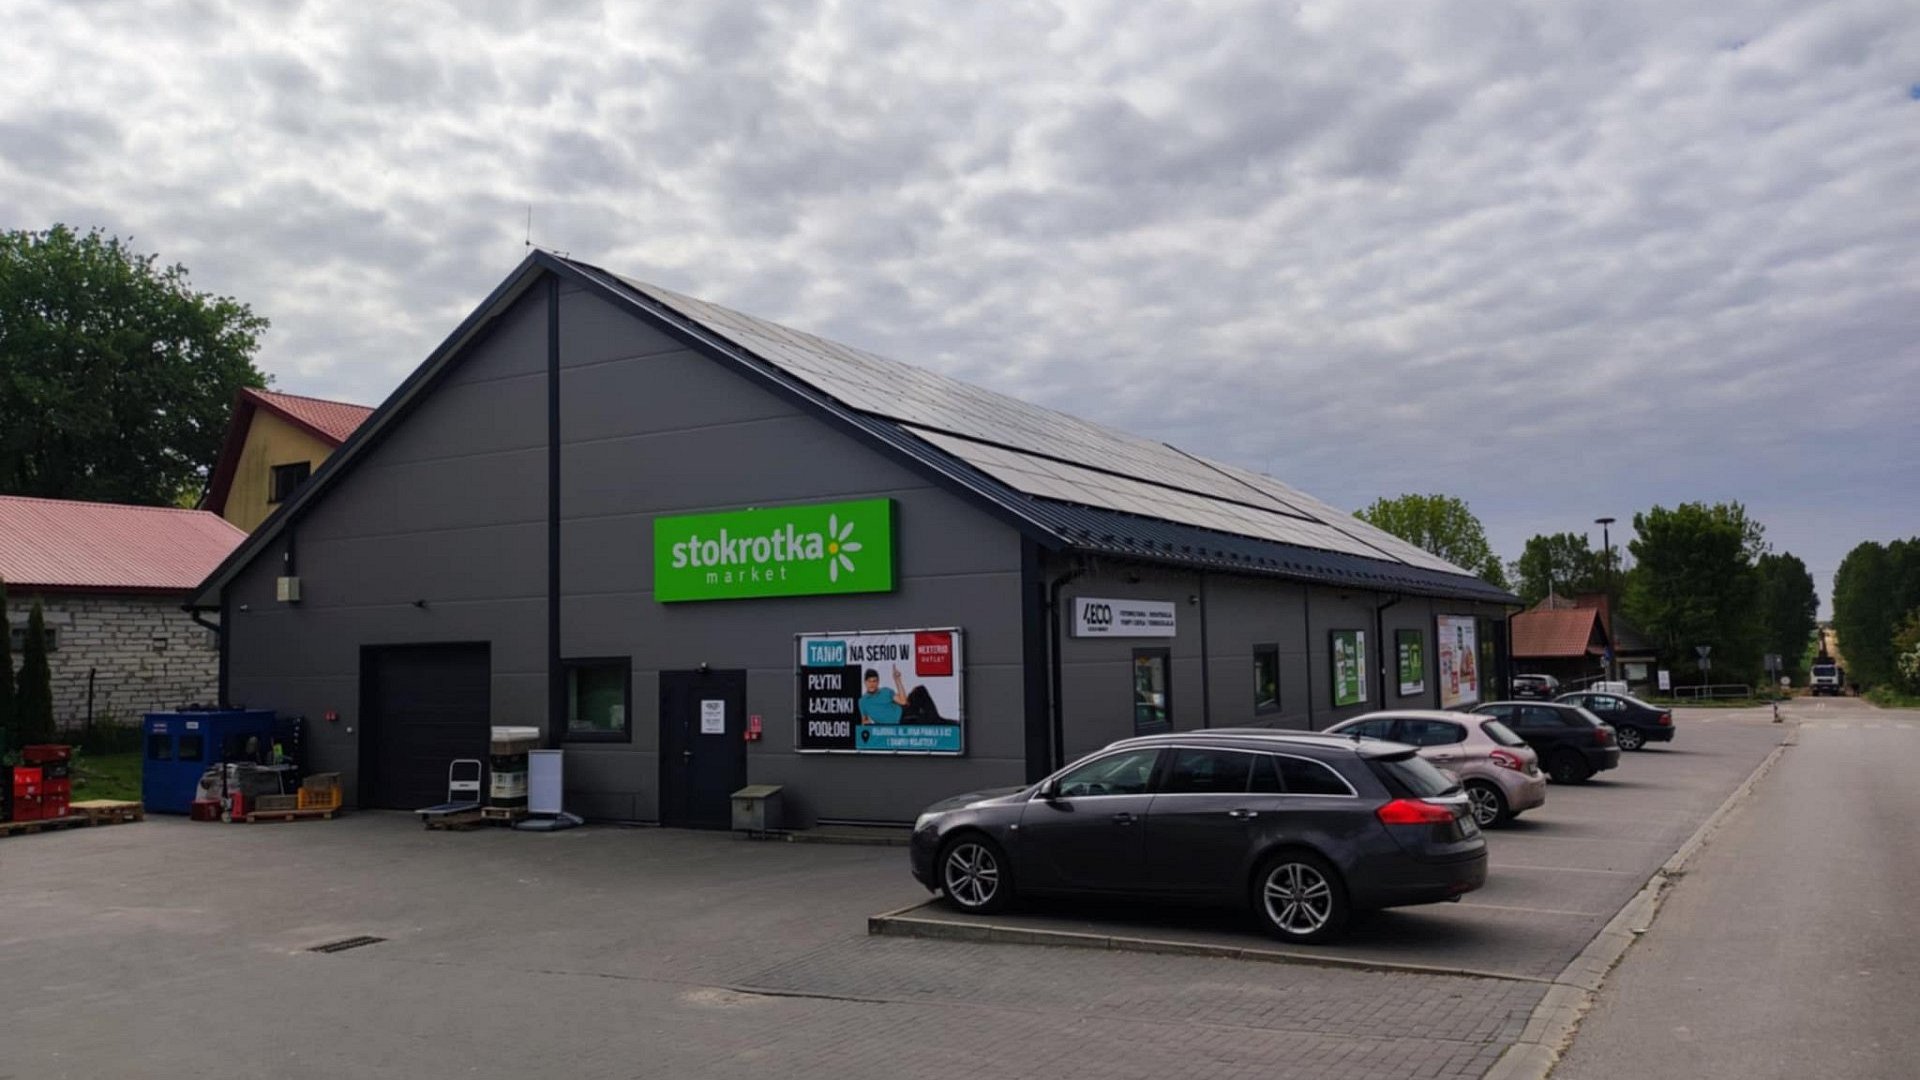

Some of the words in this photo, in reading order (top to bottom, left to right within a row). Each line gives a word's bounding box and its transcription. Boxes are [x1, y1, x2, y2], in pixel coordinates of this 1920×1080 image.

[671, 523, 824, 568] stokrotka
[706, 566, 787, 584] market
[810, 646, 842, 662] TANIO
[850, 645, 865, 661] NA
[866, 645, 897, 662] SERIO
[900, 644, 910, 660] W
[808, 674, 842, 690] PŁYTKI
[809, 697, 854, 714] ŁAZIENKI
[808, 721, 850, 737] PODŁOGI
